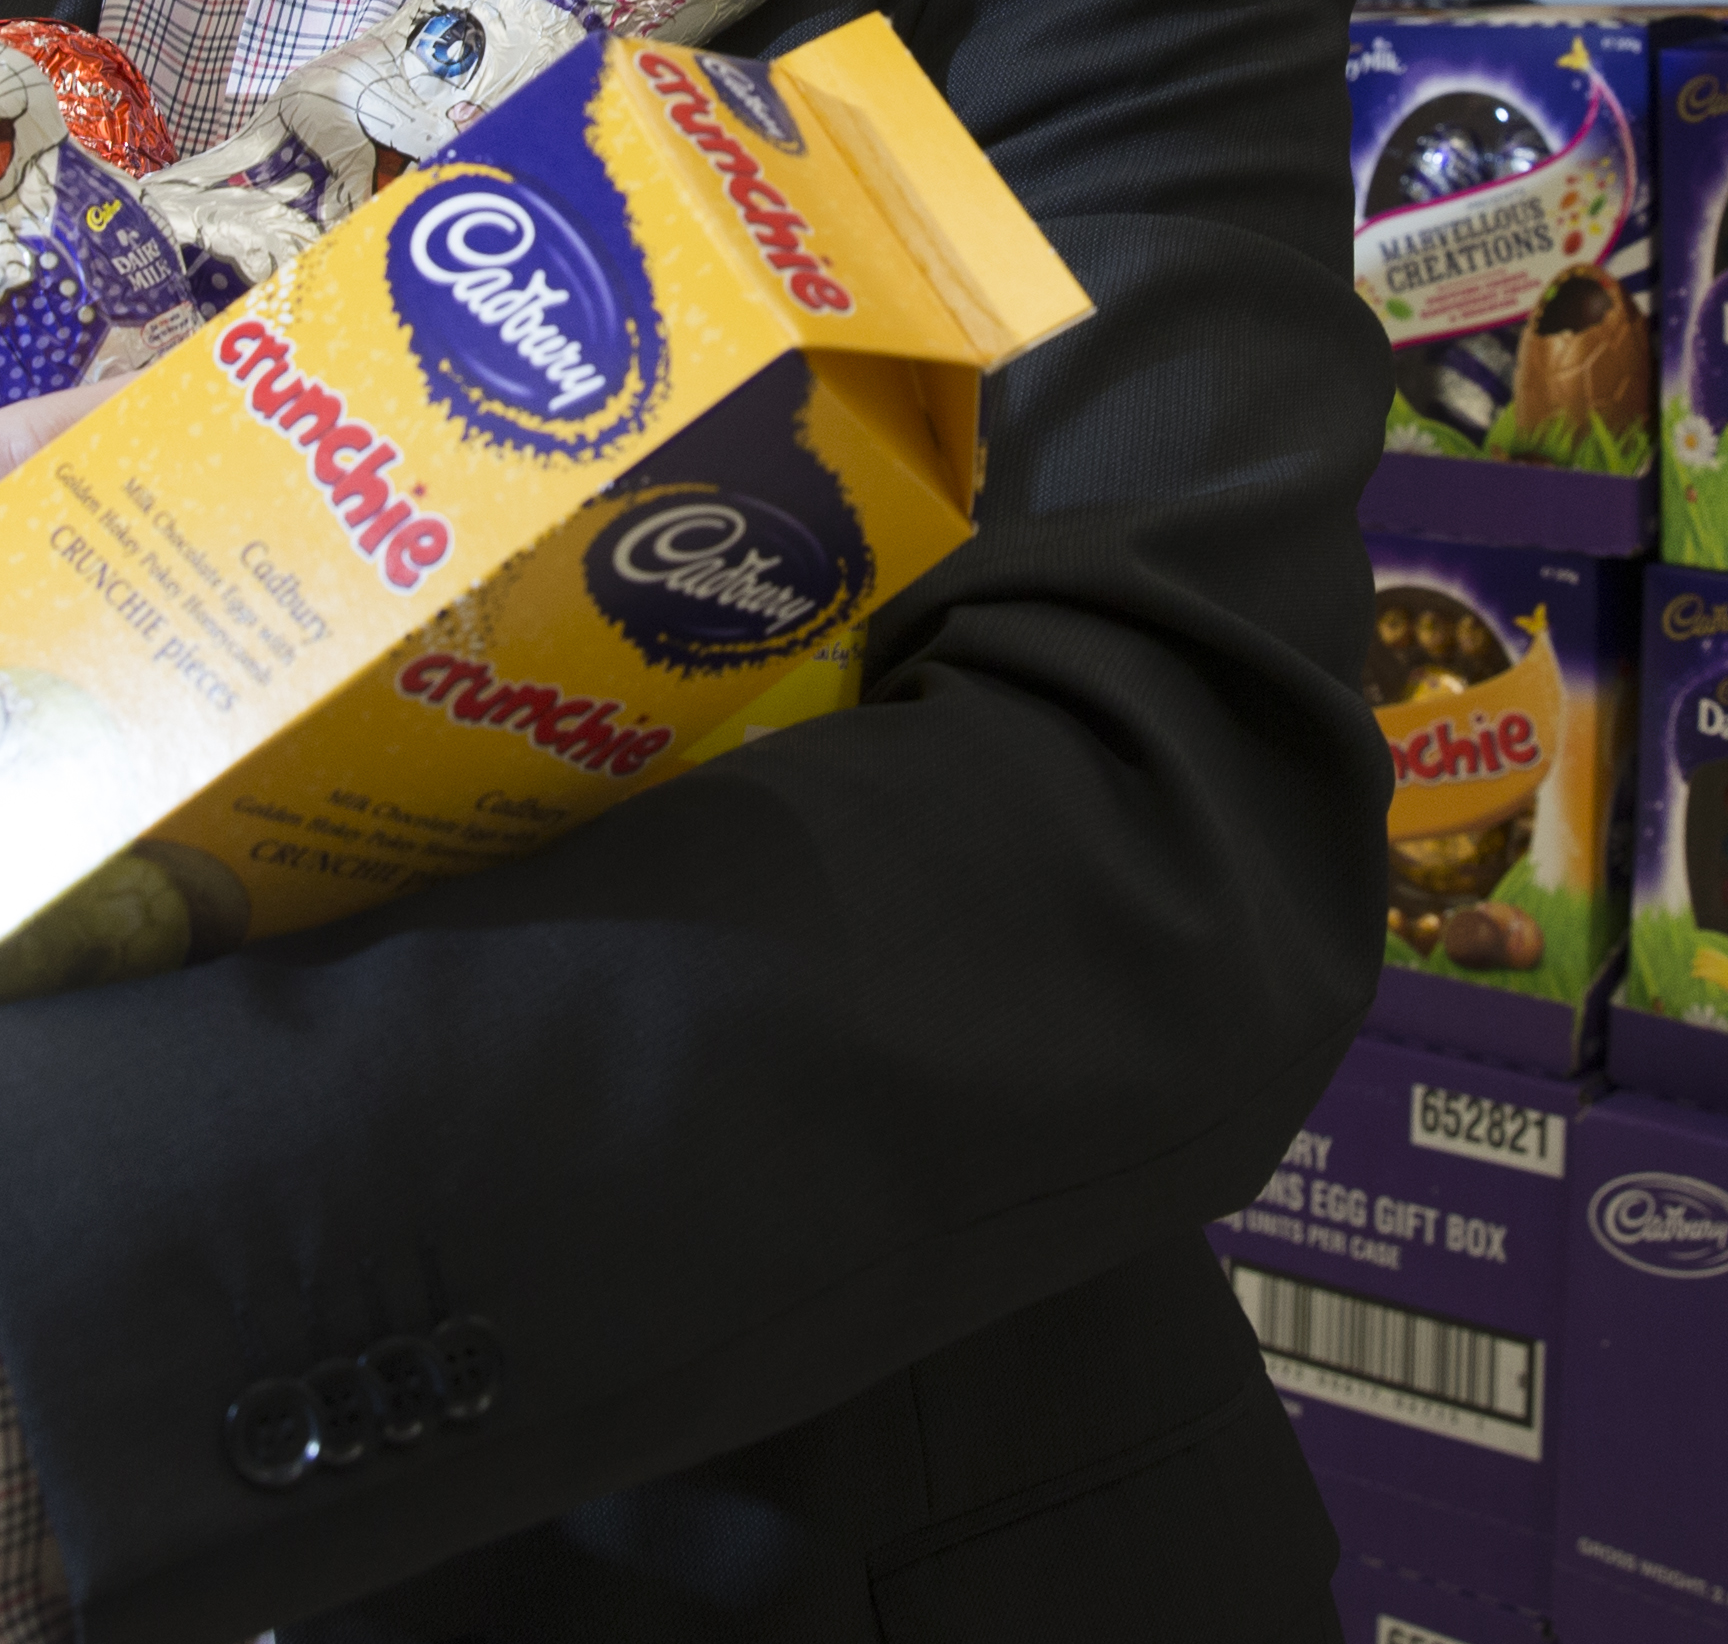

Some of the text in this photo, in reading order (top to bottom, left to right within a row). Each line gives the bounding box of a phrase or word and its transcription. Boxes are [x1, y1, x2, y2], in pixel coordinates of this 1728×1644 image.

[634, 52, 854, 314] crunchie
[1378, 196, 1547, 264] MARVELLOUS
[127, 259, 171, 292] MILK
[410, 191, 606, 412] Cadbury
[1385, 225, 1555, 296] CREATIONS
[218, 319, 451, 592] crunchie
[48, 523, 242, 713] CRUNCHIE pieces
[54, 461, 272, 687] Golden Hokey Pokey Honeycomb
[122, 476, 298, 668] Milk Chocolate Eggs with
[239, 538, 334, 645] Cadbury
[613, 503, 817, 635] Cadbury
[396, 653, 671, 777] crunchie
[1391, 713, 1540, 780] nchie
[1420, 1088, 1551, 1160] 652821
[1307, 1224, 1348, 1260] PER
[1348, 1235, 1403, 1271] CASE
[1309, 1177, 1368, 1228] EGG
[1373, 1194, 1440, 1246] GIFT
[1445, 1213, 1508, 1265] BOX
